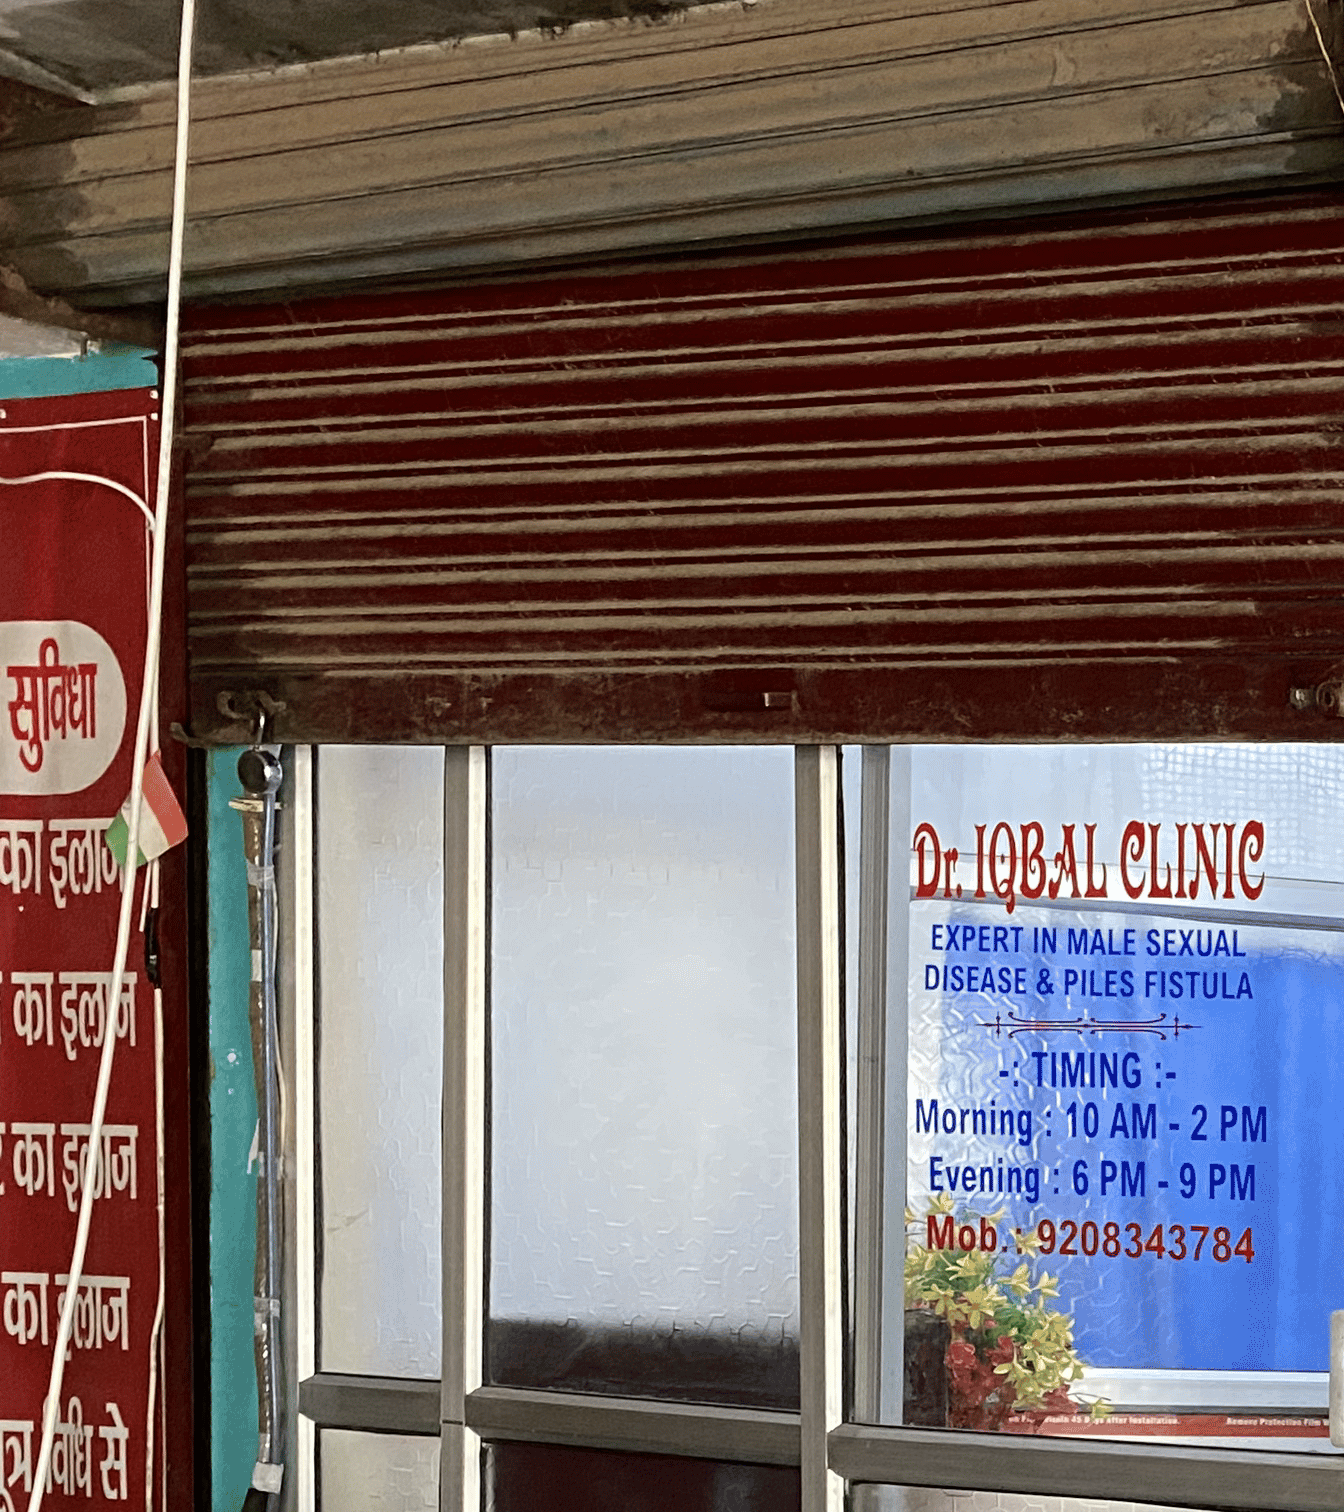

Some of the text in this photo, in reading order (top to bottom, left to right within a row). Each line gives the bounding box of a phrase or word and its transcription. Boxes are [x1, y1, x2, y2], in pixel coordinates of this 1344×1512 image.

[7, 637, 97, 772] सुविधा
[0, 819, 43, 894] का
[914, 820, 1265, 914] Dr. IQBAL CLINIC
[931, 924, 1247, 957] EXPERT IN MALE SEXUAL
[11, 971, 54, 1045] का
[925, 964, 1254, 1000] DISEASE & PILES FISTULA
[1032, 1052, 1143, 1089] TIMING
[11, 1122, 55, 1196] का
[915, 1098, 1033, 1147] Morning
[1066, 1102, 1100, 1139] 10
[1110, 1104, 1157, 1141] AM
[1190, 1105, 1208, 1141] 2
[1220, 1106, 1268, 1143] PM
[930, 1156, 1040, 1203] Evening
[1072, 1160, 1089, 1196] 6
[1100, 1160, 1146, 1198] PM
[1179, 1163, 1196, 1199] 9
[1208, 1165, 1256, 1202] PM
[1037, 1219, 1256, 1264] 9208343784
[1, 1271, 49, 1345] का
[99, 1402, 129, 1500] से
